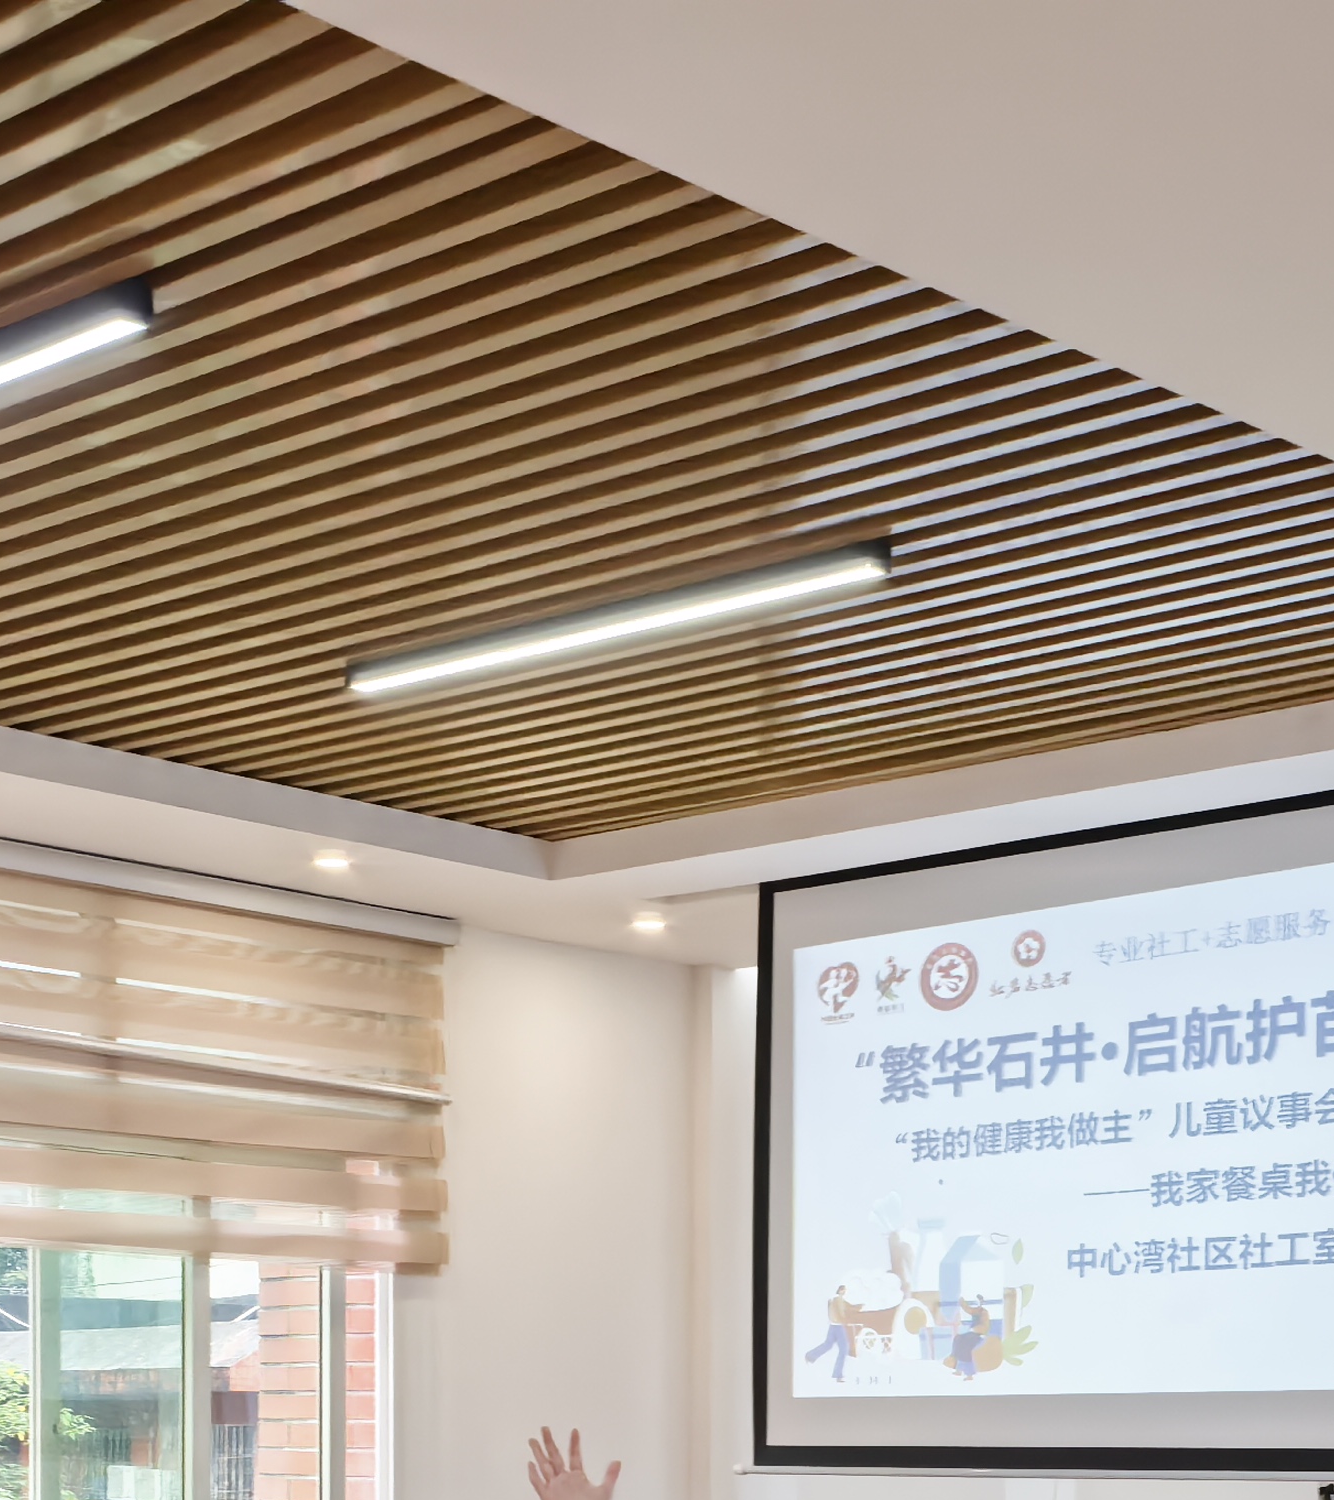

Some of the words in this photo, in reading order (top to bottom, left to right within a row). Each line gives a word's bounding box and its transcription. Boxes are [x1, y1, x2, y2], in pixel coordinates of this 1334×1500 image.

[1092, 908, 1331, 966] 专业社工+志愿服务
